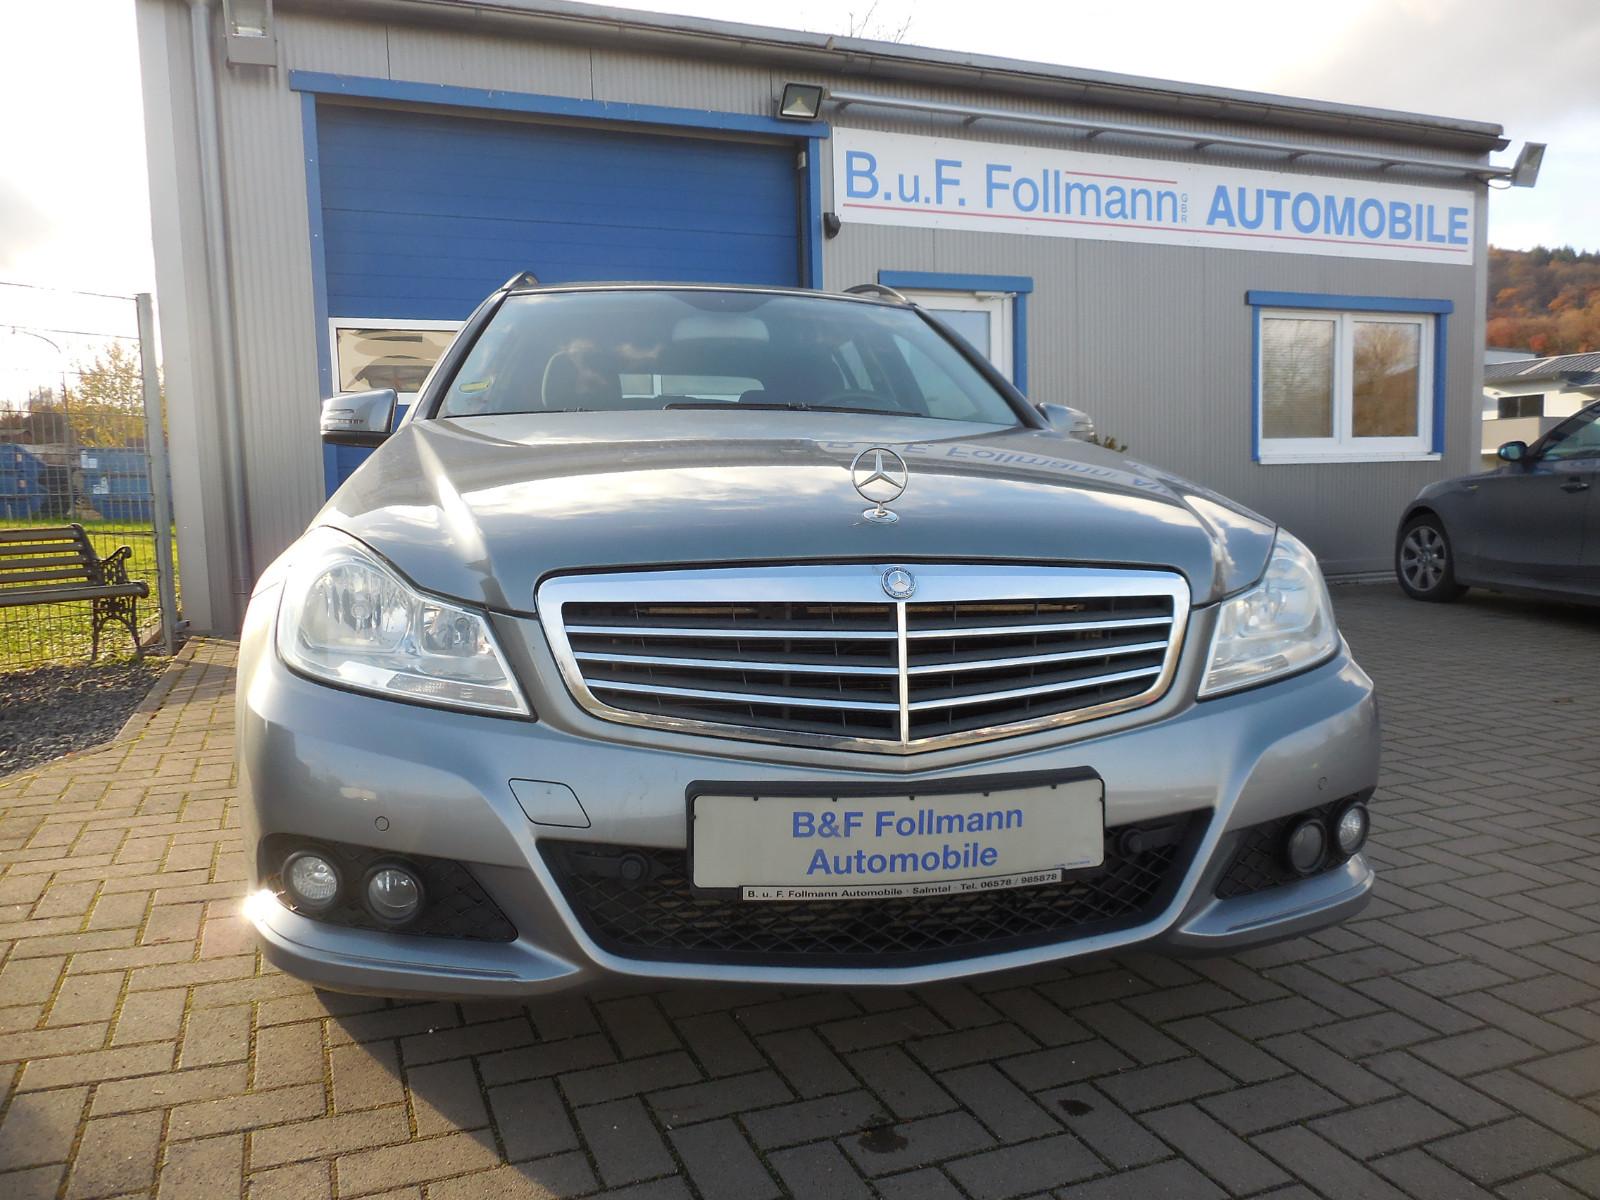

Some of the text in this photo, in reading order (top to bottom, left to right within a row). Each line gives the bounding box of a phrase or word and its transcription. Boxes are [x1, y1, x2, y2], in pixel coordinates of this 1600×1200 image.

[986, 163, 1178, 224] Follmann
[1206, 184, 1469, 246] AUTOMOBILE
[792, 808, 1023, 838] B&F Follmann
[806, 842, 998, 875] Automobile
[747, 890, 759, 898] B.
[776, 890, 784, 898] F.
[788, 889, 838, 898] Follmann
[841, 888, 903, 897] Automobile
[912, 885, 951, 895] Salmtal
[960, 882, 978, 890] Tel.
[980, 880, 1012, 888] 06578
